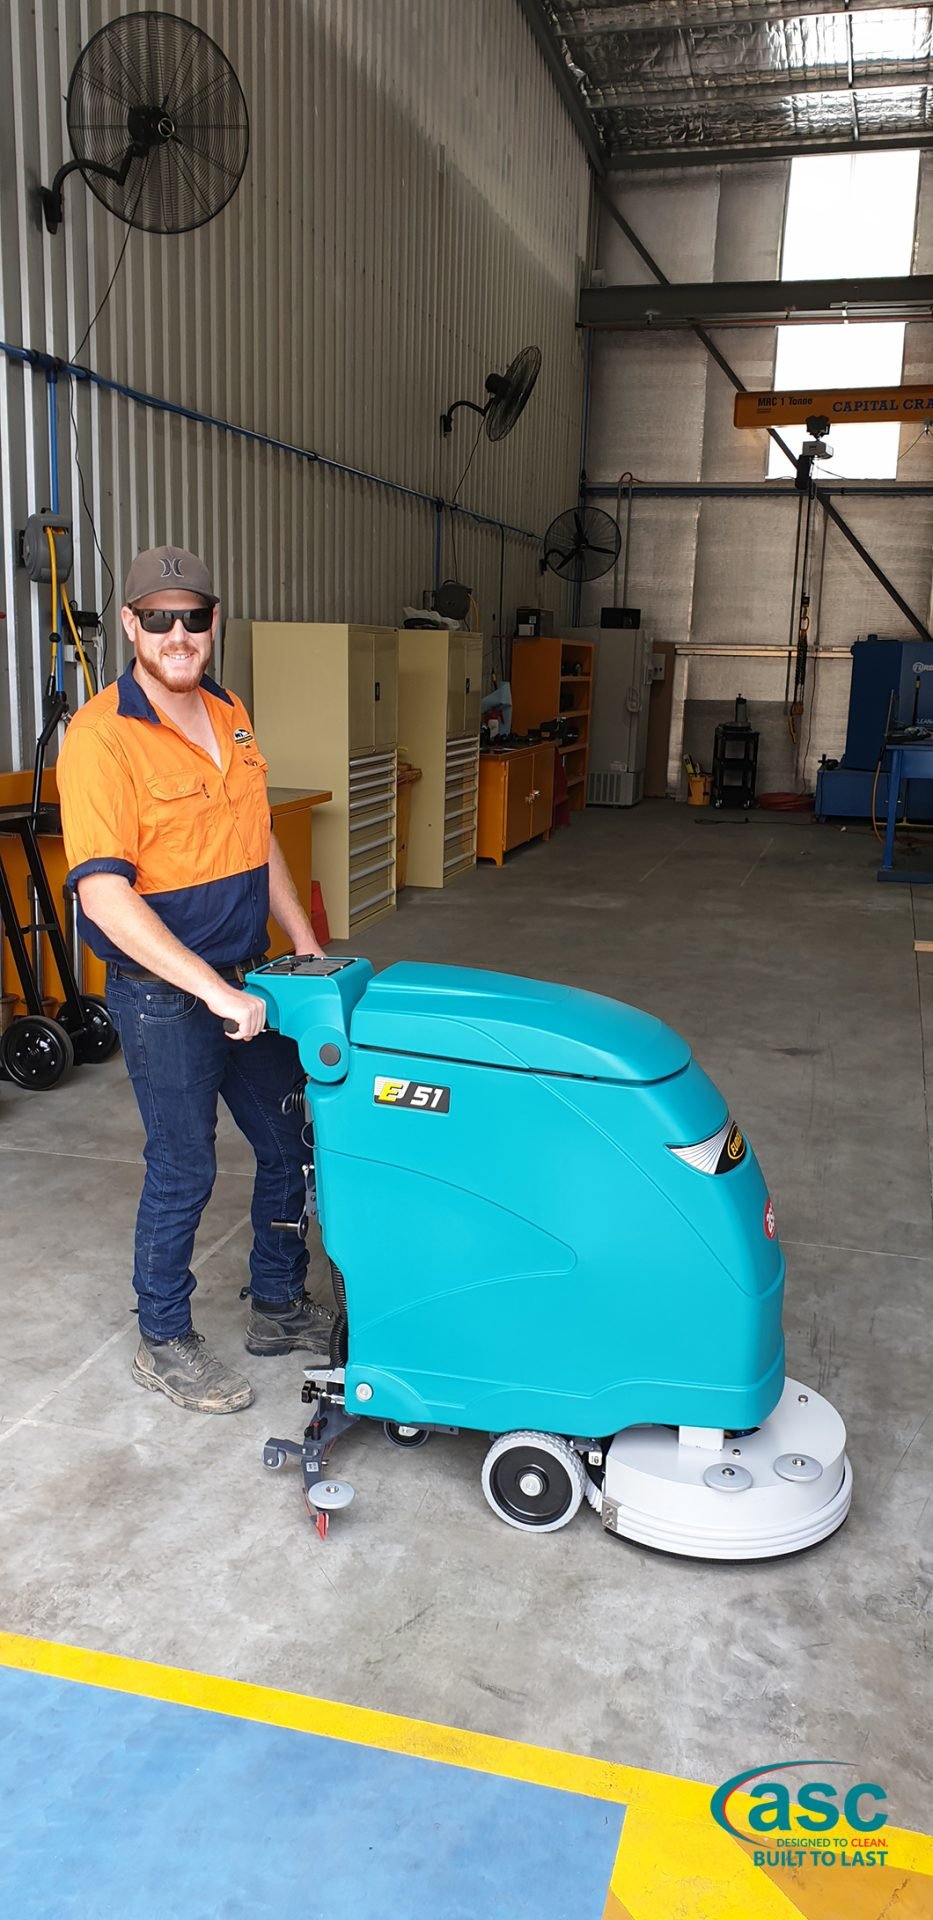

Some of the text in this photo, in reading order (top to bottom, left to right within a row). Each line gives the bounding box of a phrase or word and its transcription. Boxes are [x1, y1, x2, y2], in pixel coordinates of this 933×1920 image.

[758, 396, 813, 406] MRC 1 Tonne
[832, 399, 899, 413] CAPITAL
[377, 1081, 444, 1109] E 51
